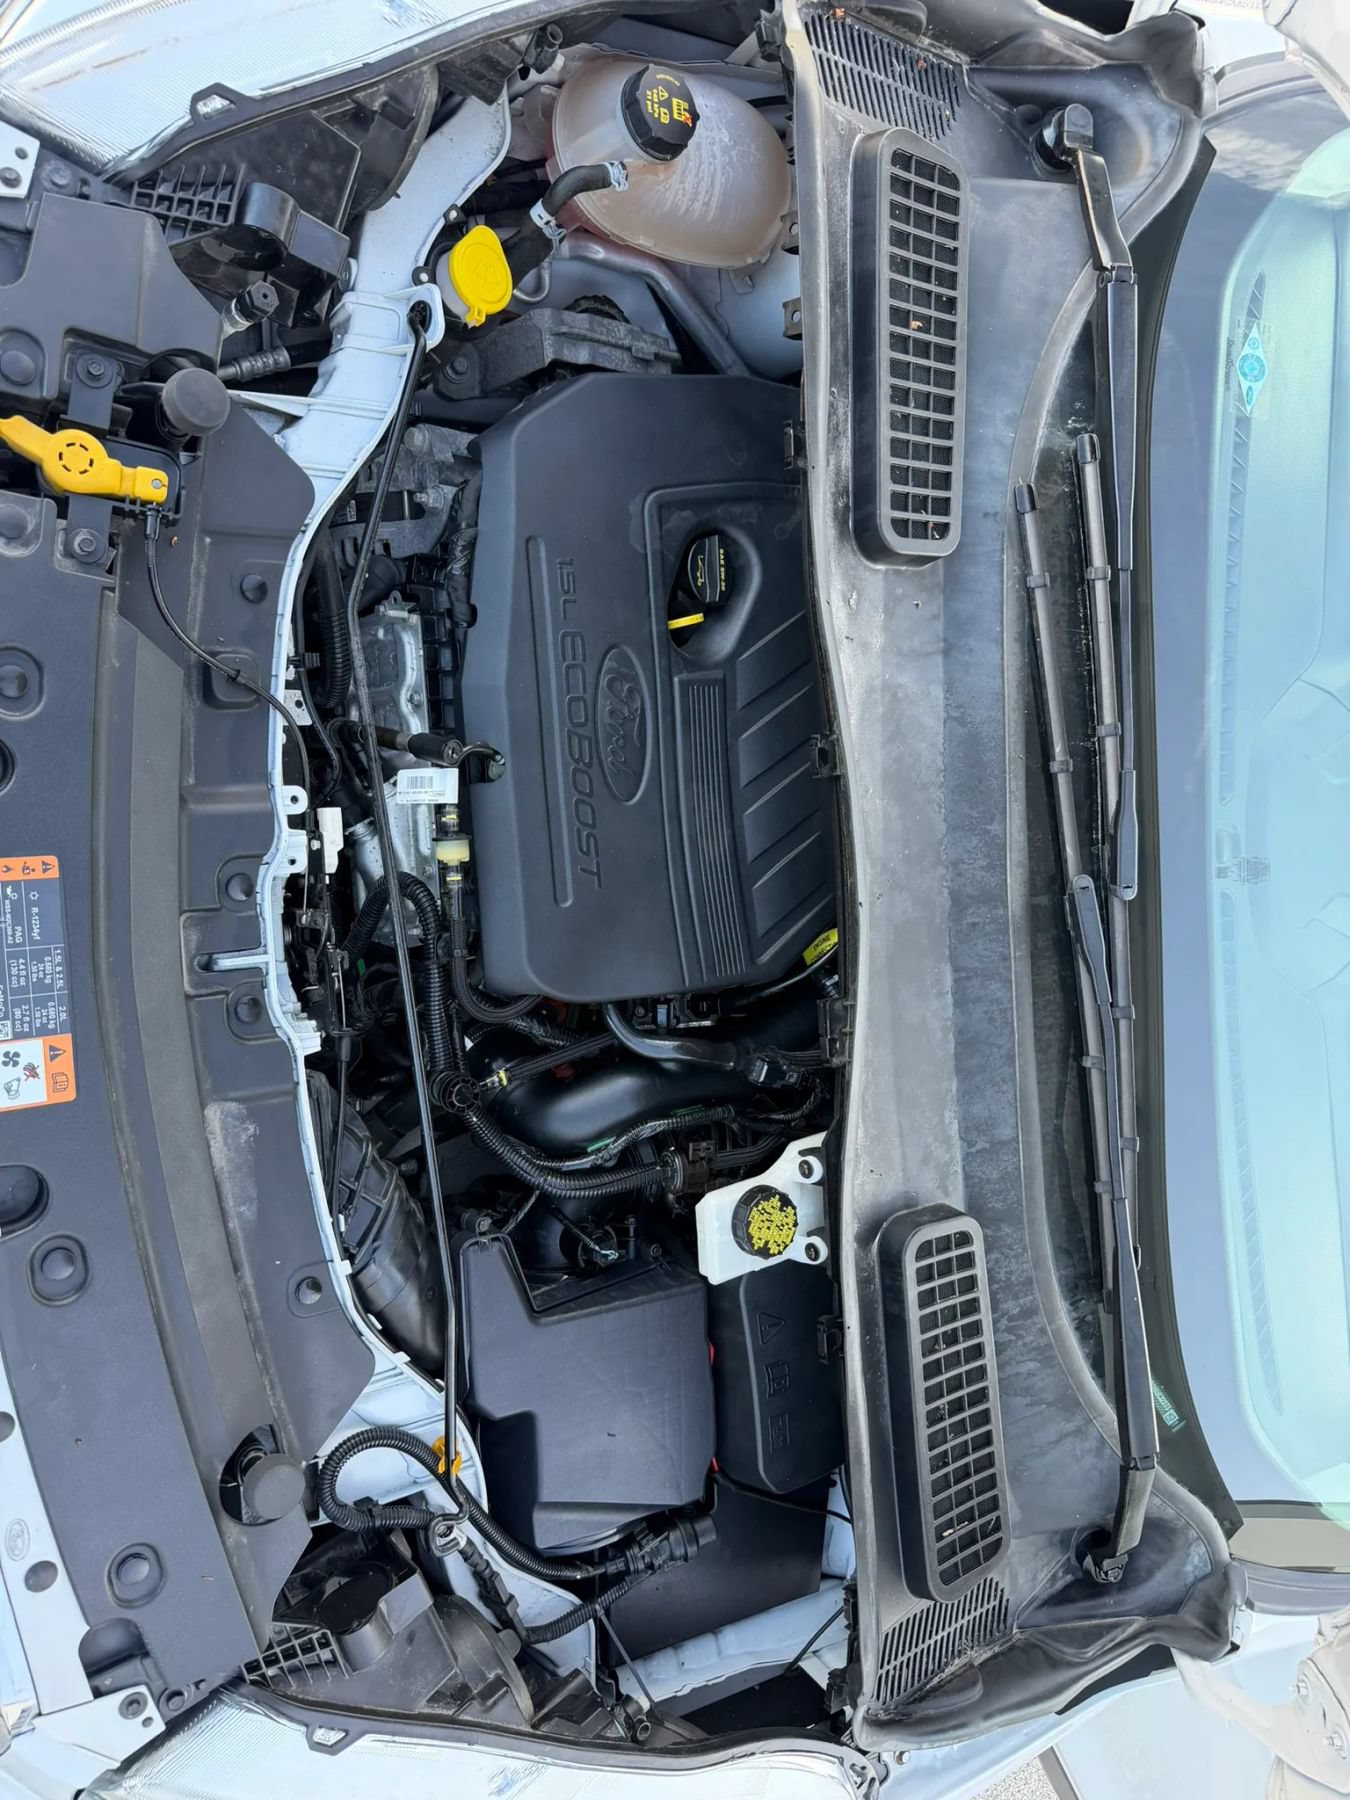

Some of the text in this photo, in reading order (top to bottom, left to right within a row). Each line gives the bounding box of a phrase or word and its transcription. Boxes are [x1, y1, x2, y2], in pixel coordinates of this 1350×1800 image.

[556, 558, 577, 620] 1.5L
[604, 674, 641, 776] Ford
[31, 907, 40, 940] R-1234yf
[9, 960, 18, 975] (130
[56, 974, 64, 989] 2.5L
